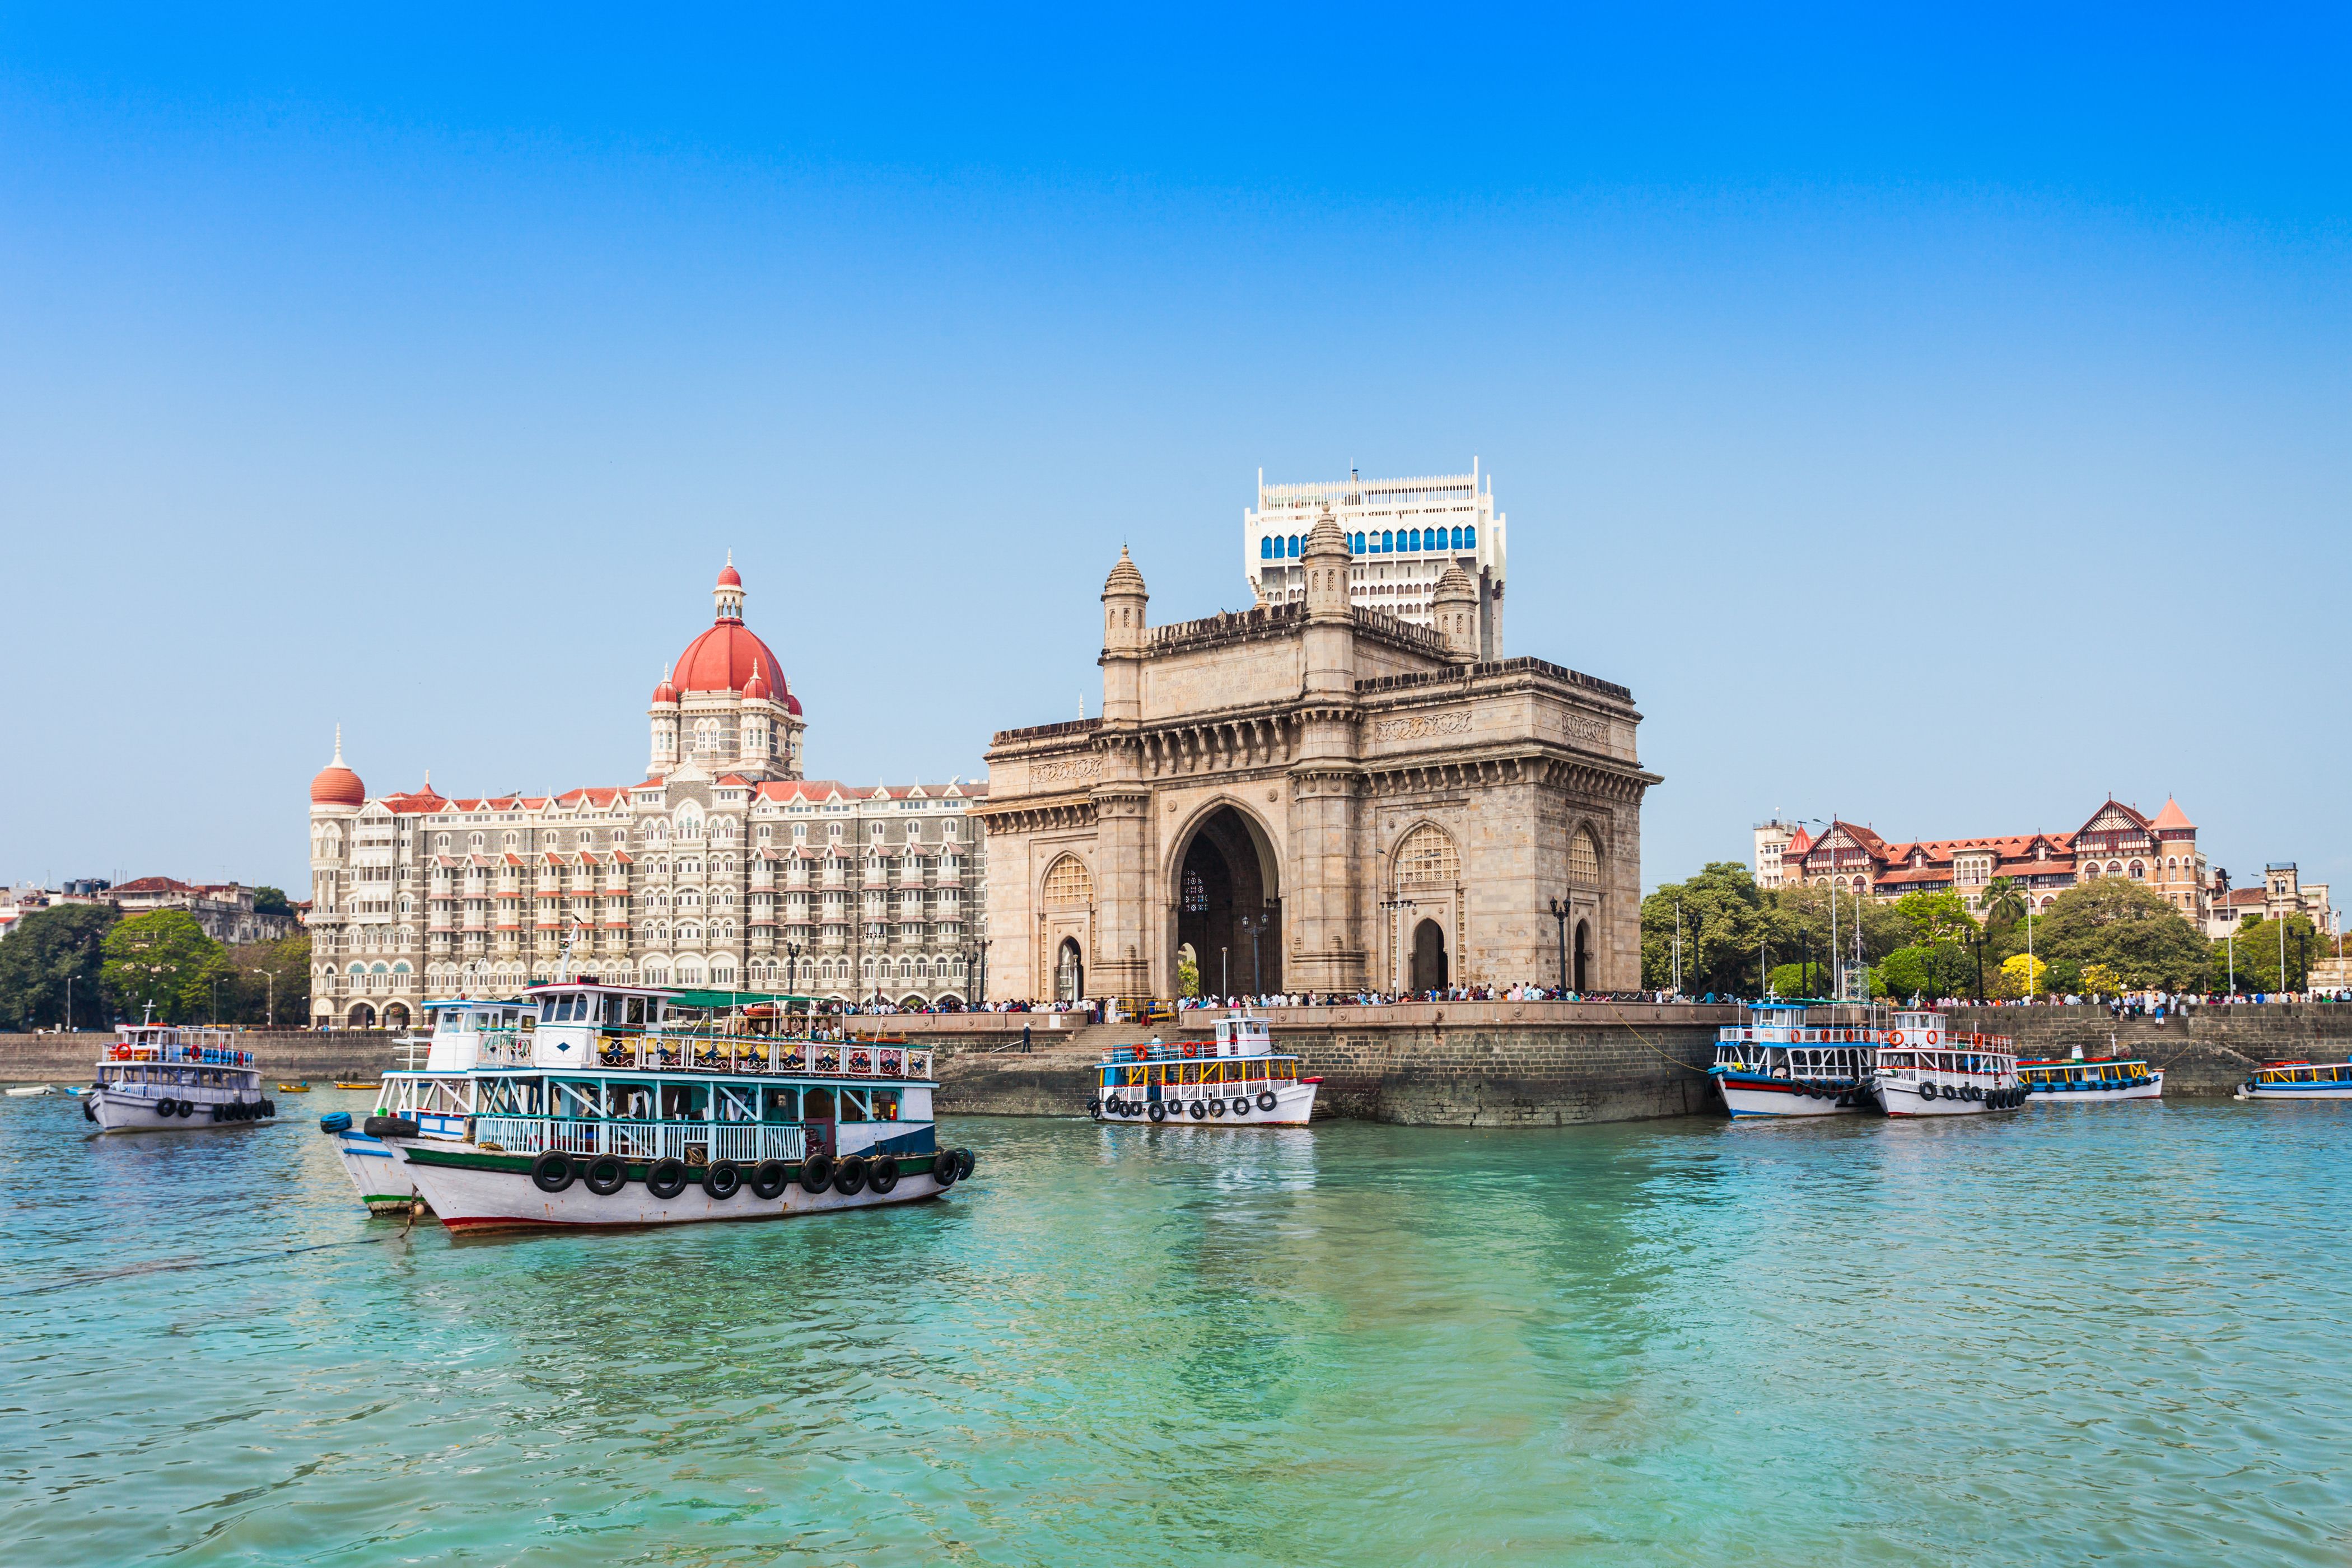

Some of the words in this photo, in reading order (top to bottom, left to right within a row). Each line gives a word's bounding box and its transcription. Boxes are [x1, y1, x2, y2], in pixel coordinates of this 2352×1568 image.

[1158, 672, 1183, 682] ERECTED
[1262, 655, 1289, 665] LANDING
[1200, 674, 1216, 683] THEIR
[1221, 670, 1248, 679] IMPERIAL
[1253, 663, 1289, 674] MAJESTIES
[1177, 683, 1205, 694] GEORGE
[1239, 675, 1263, 684] QUEEN
[1185, 690, 1211, 700] SECOND
[1228, 682, 1261, 694] DECEMBER
